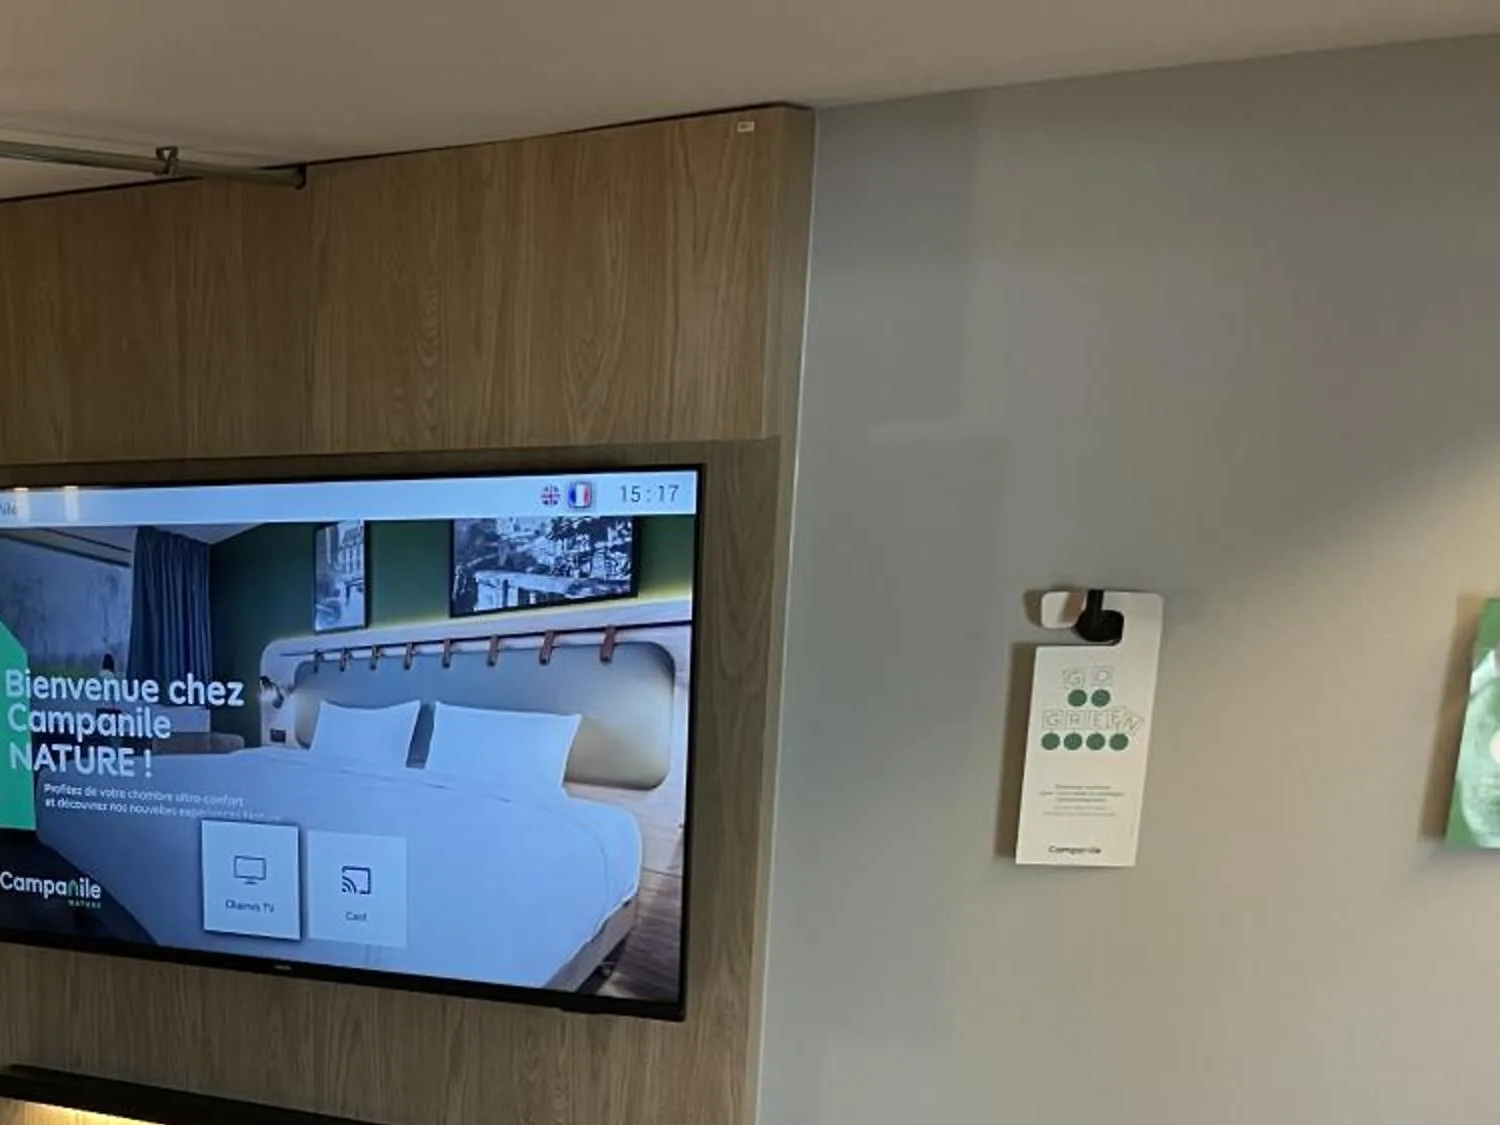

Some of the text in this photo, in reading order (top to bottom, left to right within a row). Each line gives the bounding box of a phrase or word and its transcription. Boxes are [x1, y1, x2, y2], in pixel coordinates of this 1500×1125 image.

[621, 484, 679, 503] 15:17
[5, 669, 245, 706] Bienvenue chez
[7, 703, 172, 742] Campanile
[9, 742, 136, 777] NATURE
[44, 783, 82, 796] Profitez
[84, 785, 97, 797] de
[100, 787, 126, 799] votre
[45, 798, 55, 808] et
[109, 803, 127, 813] nos
[0, 871, 101, 899] Campanile
[345, 911, 367, 922] Cast
